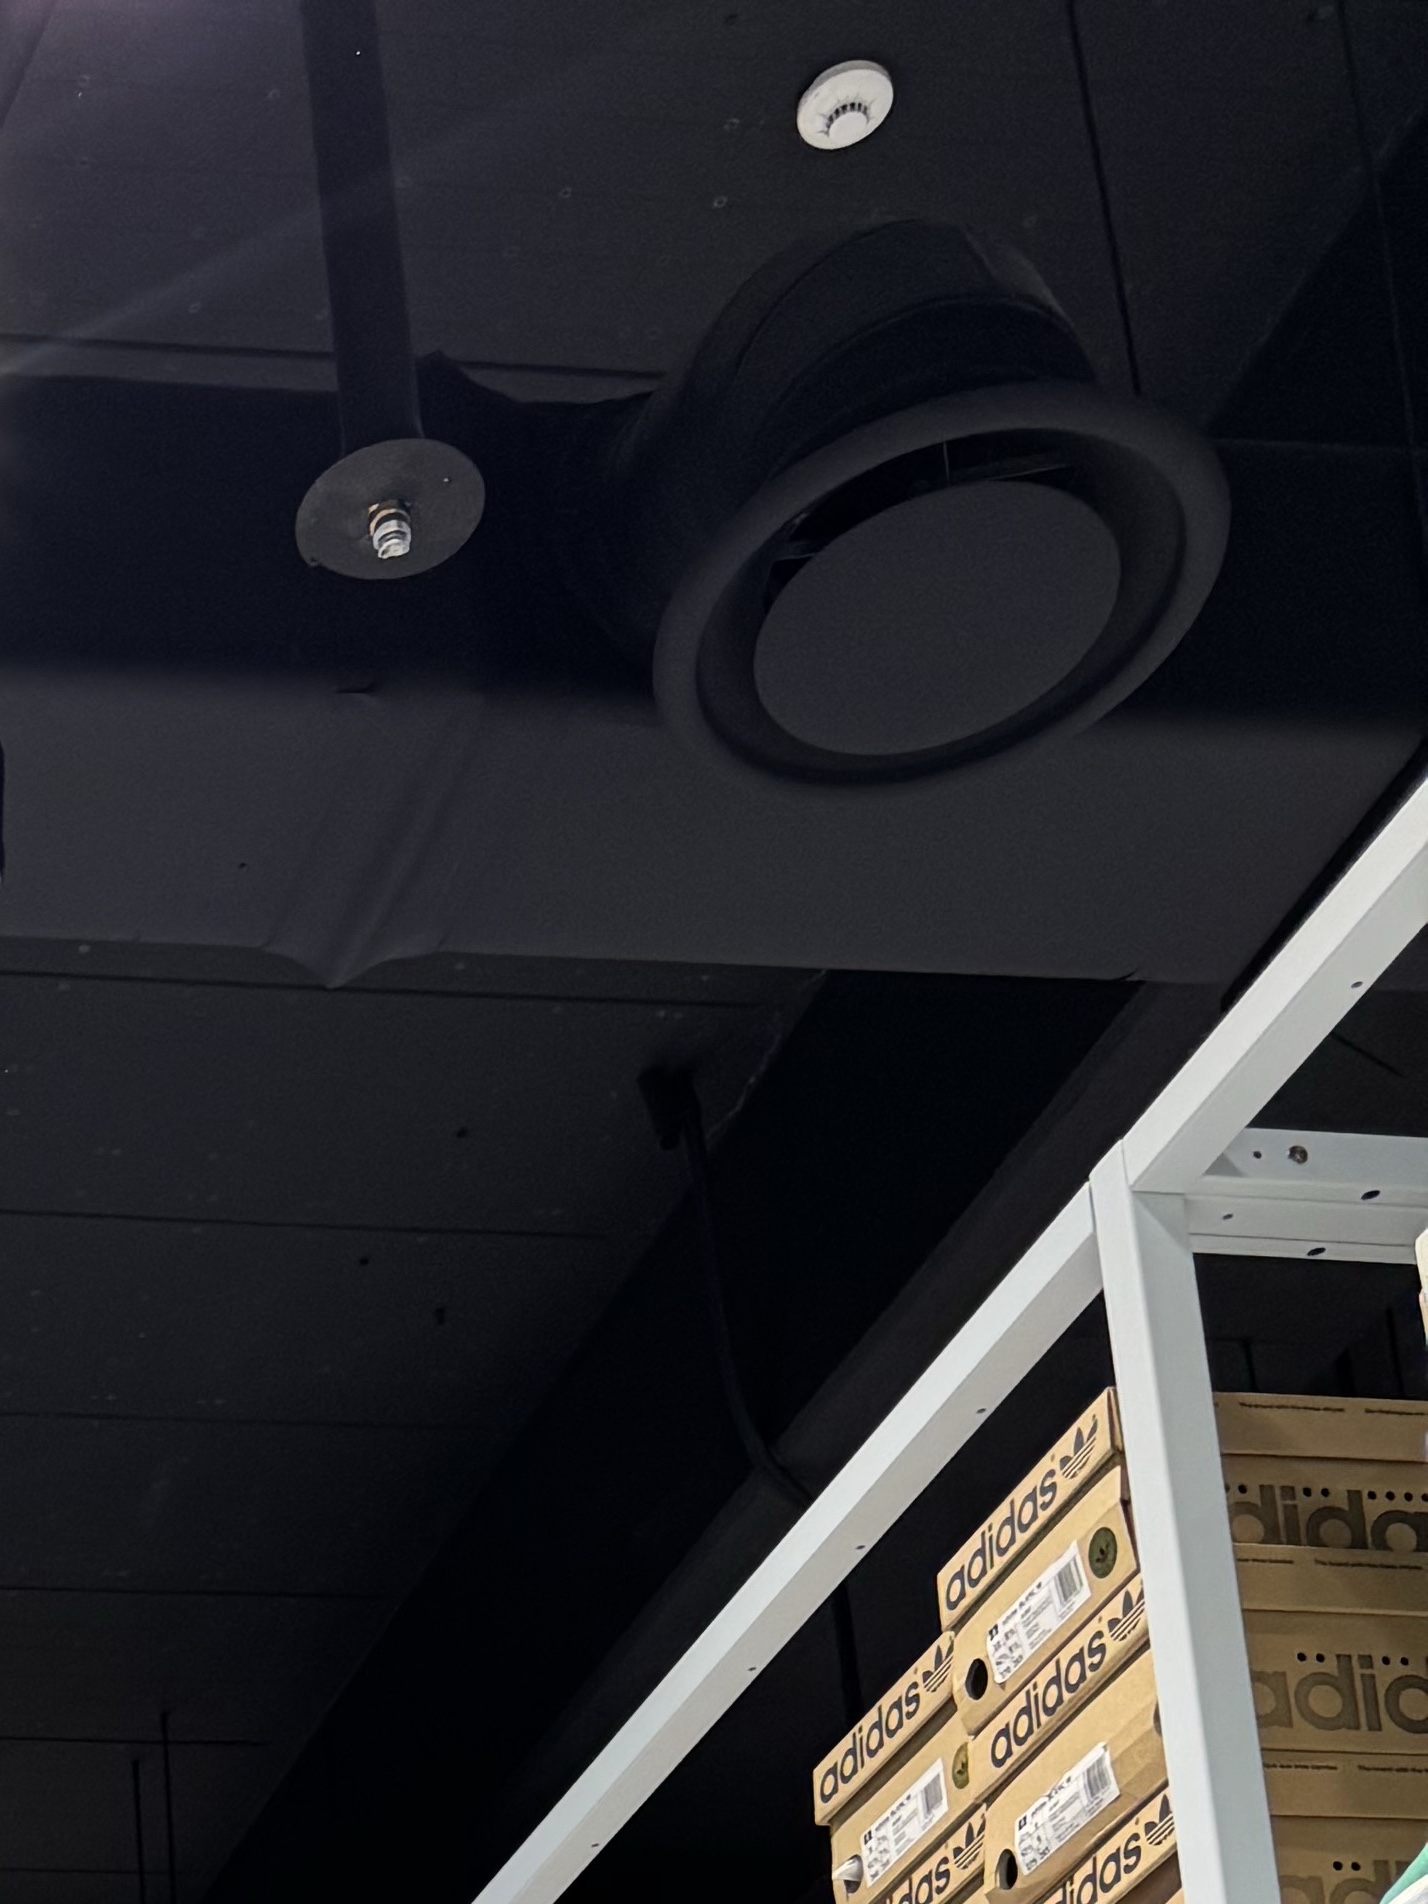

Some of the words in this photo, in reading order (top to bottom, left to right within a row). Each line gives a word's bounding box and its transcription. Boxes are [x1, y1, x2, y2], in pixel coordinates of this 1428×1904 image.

[945, 1468, 1057, 1611] adidas
[1231, 1484, 1428, 1552] dida
[819, 1681, 919, 1804] adidas
[990, 1630, 1107, 1768] adidas
[1257, 1654, 1428, 1733] adid
